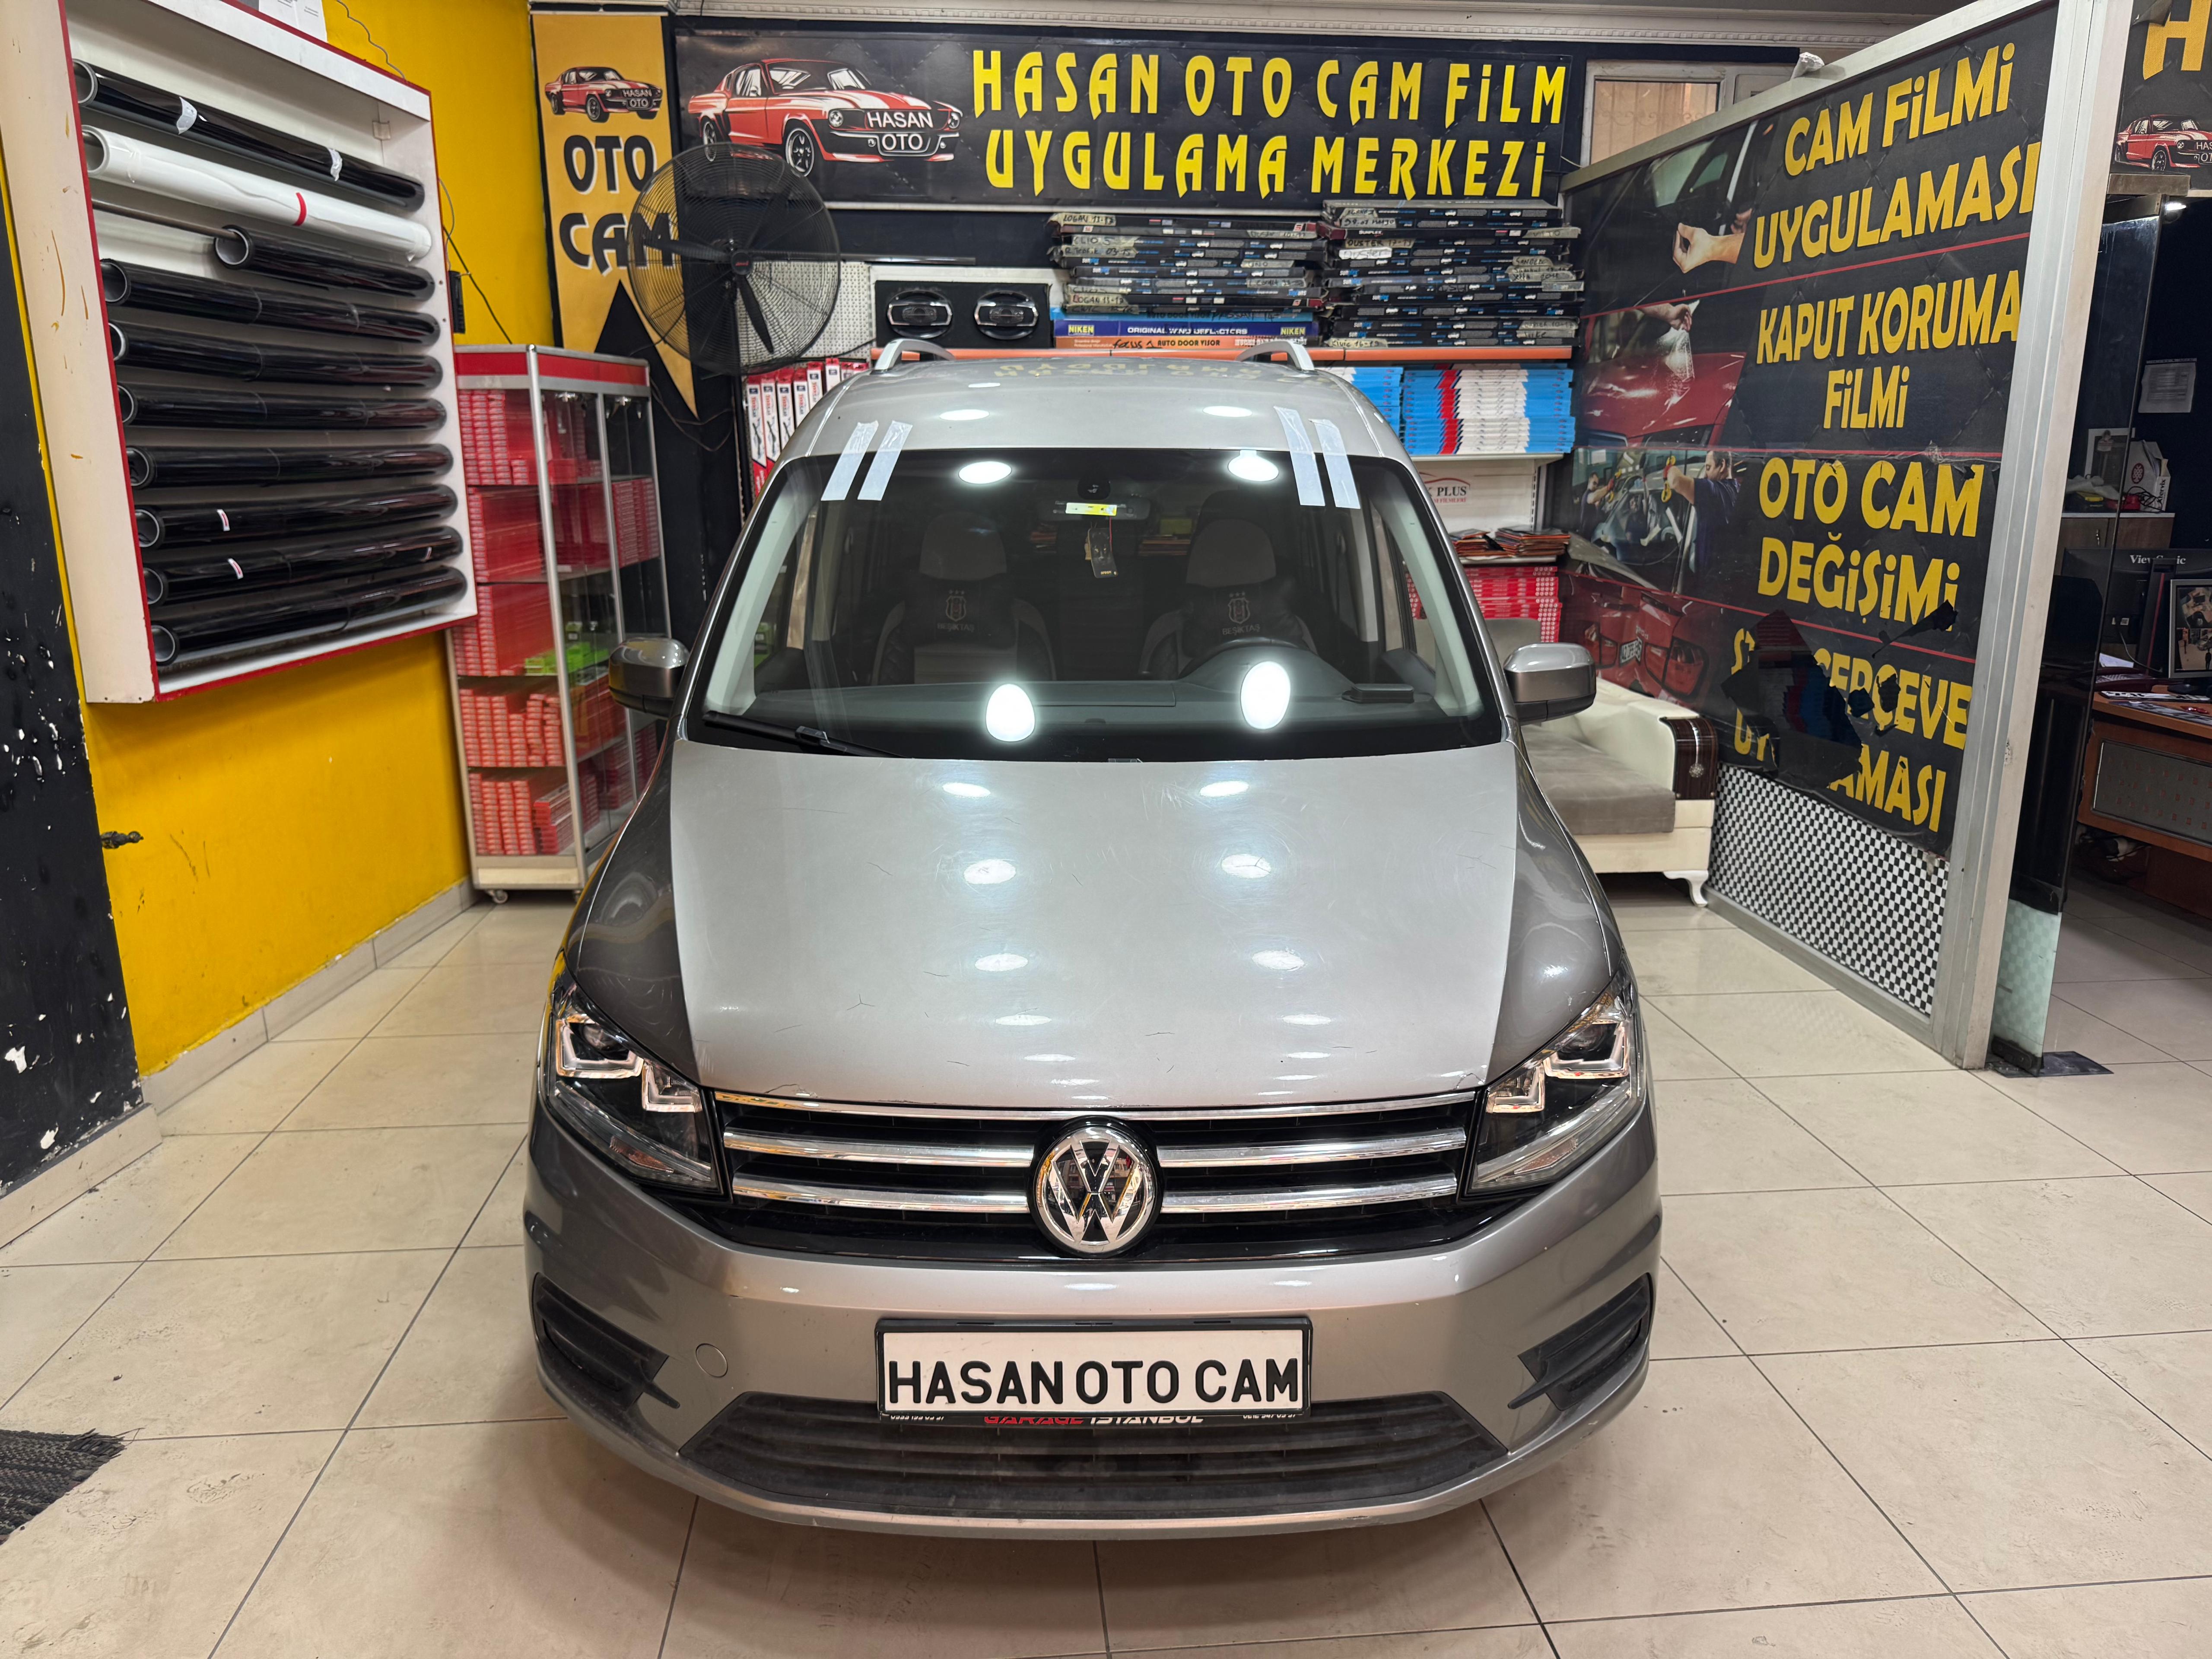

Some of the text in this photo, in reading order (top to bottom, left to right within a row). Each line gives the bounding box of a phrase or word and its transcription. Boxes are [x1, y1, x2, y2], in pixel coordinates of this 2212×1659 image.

[623, 88, 652, 97] HASAN
[629, 99, 648, 107] OTO
[973, 51, 1158, 119] HASAN
[1185, 55, 1292, 118] OTO
[1316, 59, 1418, 127] CAM
[867, 111, 933, 129] HASAN
[882, 134, 923, 150] OTO
[1785, 92, 1873, 176] CAM
[563, 135, 657, 194] OTO
[986, 129, 1287, 198] UYGULAMA
[1754, 141, 2041, 268] UYGULAMASI
[559, 212, 679, 276] CAM
[1069, 326, 1093, 334] NIKEN
[1757, 270, 2021, 364] KAPUT KORUMA
[1437, 486, 1466, 496] PLUS
[1759, 457, 1984, 537] OTO CAM
[889, 1358, 1297, 1404] HASAN OTO CAM
